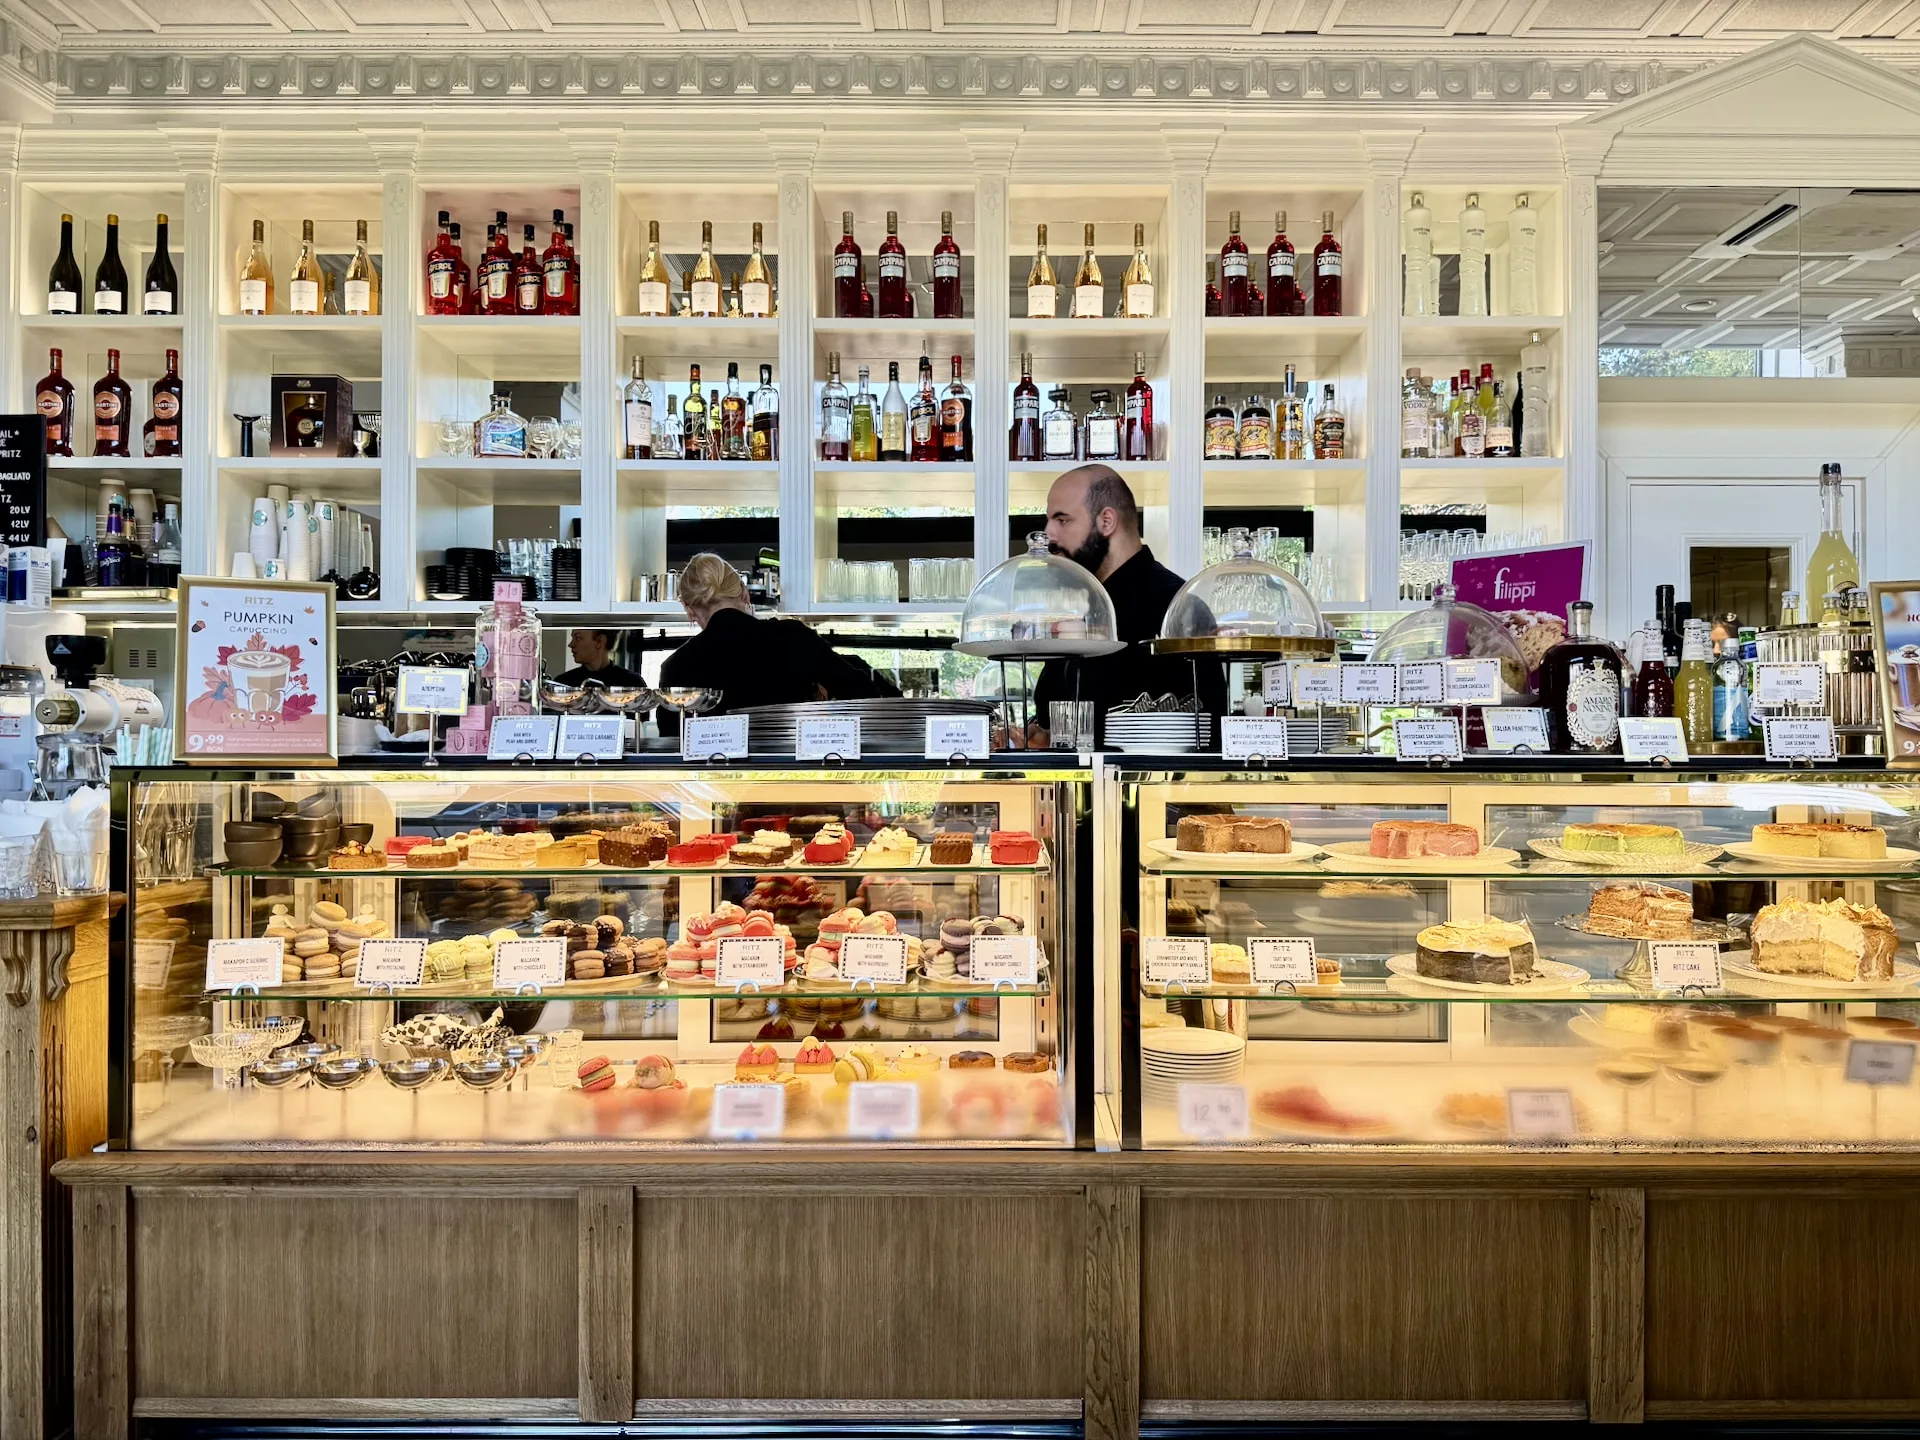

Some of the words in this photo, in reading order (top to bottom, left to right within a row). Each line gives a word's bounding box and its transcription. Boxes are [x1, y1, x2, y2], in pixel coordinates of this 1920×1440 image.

[429, 263, 452, 274] APEROL
[487, 263, 509, 274] APEROL
[544, 261, 567, 273] APEROL
[1403, 400, 1427, 410] VODKA
[1494, 567, 1536, 604] filippi
[245, 597, 274, 605] RITZ
[224, 611, 294, 625] PUMPKIN
[229, 626, 288, 635] CAPUCCINO
[1583, 696, 1613, 705] AMARO
